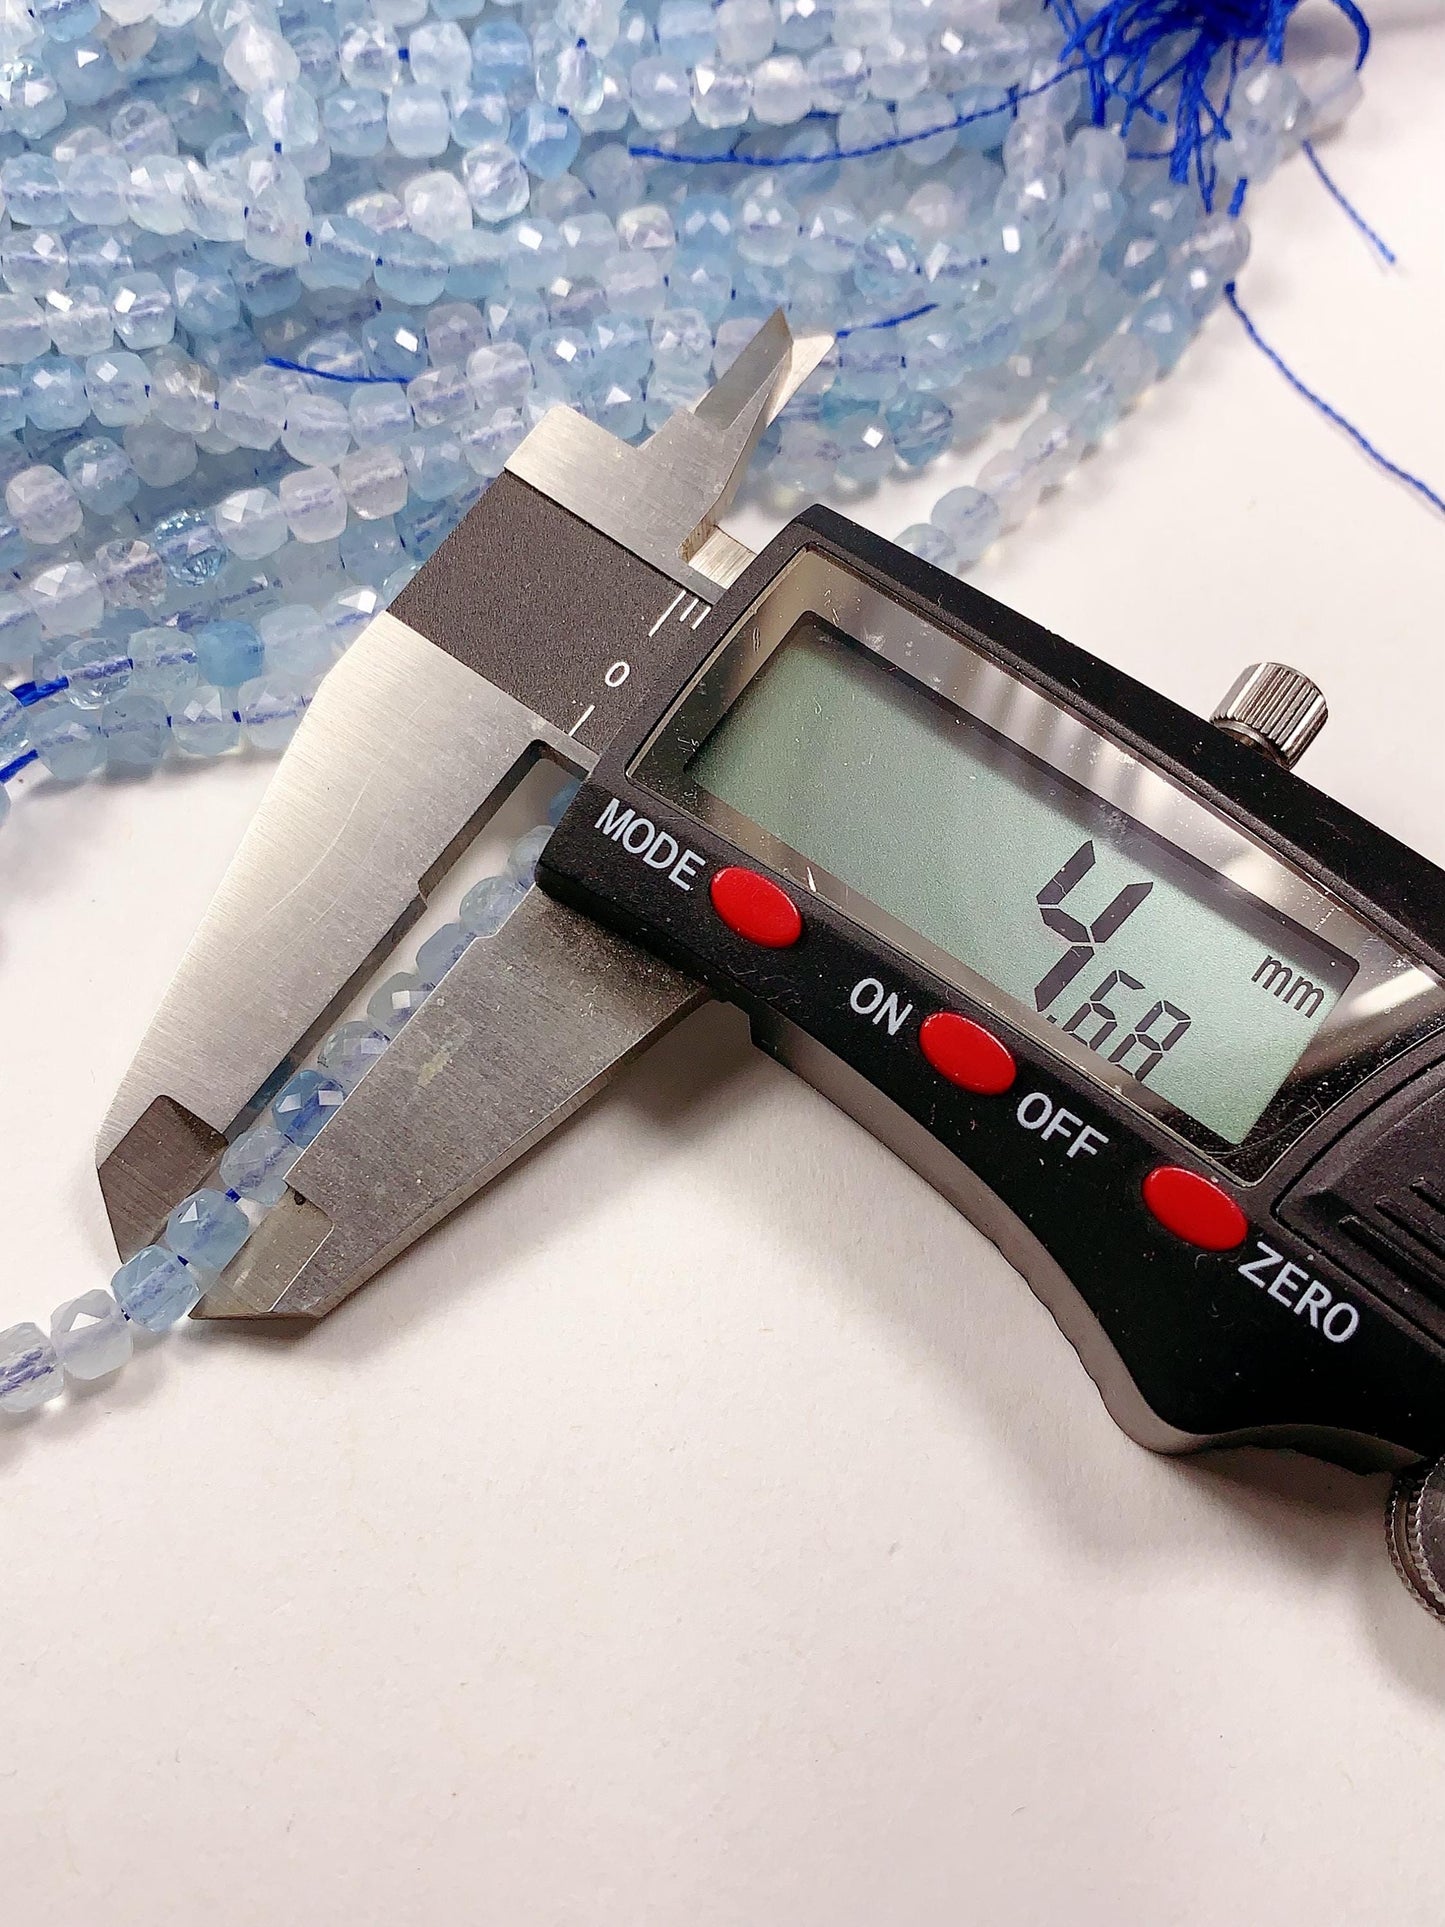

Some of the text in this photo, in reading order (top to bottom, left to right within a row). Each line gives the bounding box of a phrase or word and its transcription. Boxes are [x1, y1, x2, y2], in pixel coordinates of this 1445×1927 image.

[605, 661, 630, 687] 0
[595, 798, 706, 890] MODE
[1034, 839, 1325, 1082] 4.68 mm
[850, 977, 914, 1036] ON
[1015, 1091, 1110, 1160] OFF
[1238, 1240, 1360, 1344] ZERO
